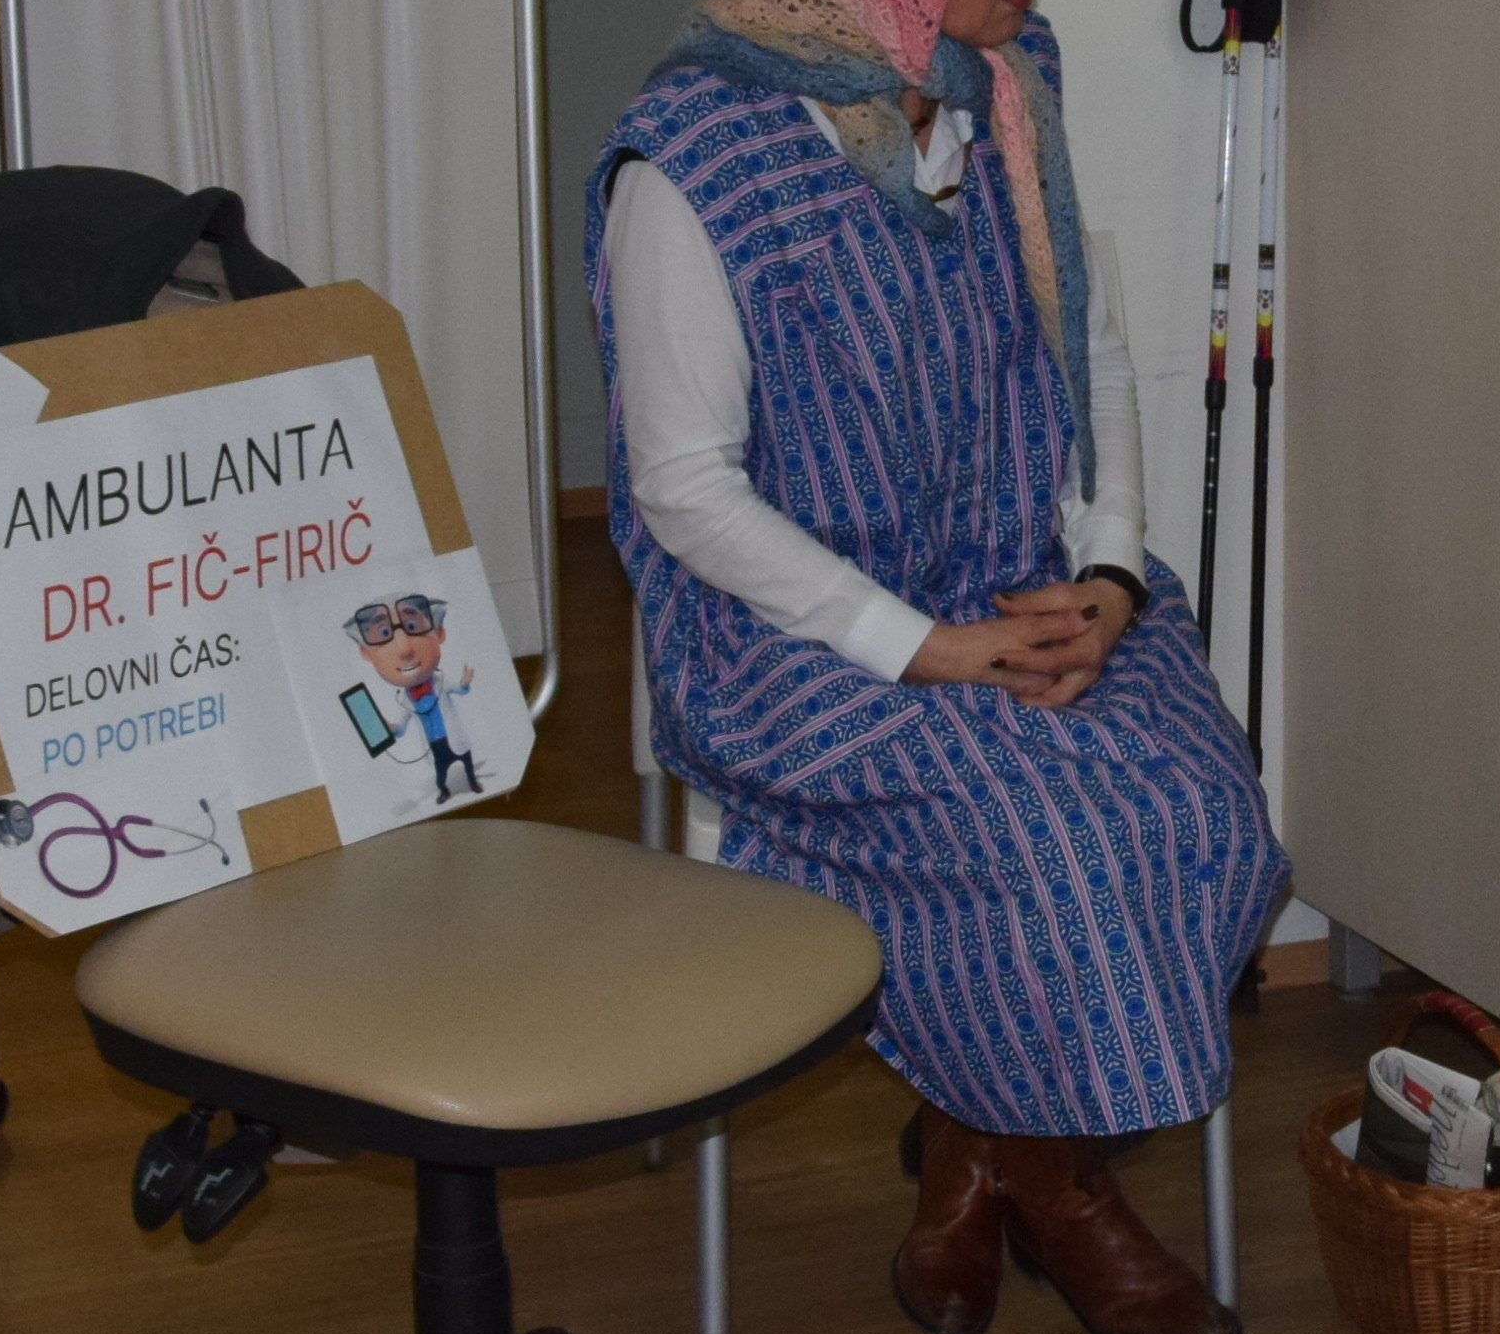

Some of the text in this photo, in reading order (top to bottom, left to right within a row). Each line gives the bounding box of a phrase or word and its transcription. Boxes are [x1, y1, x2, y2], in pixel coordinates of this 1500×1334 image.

[4, 418, 353, 549] AMBULANTA
[43, 496, 372, 643] DR. FIČ-FIRIČ
[25, 632, 241, 718] DELOVNI ČAS:
[42, 693, 226, 774] PO POTREBI
